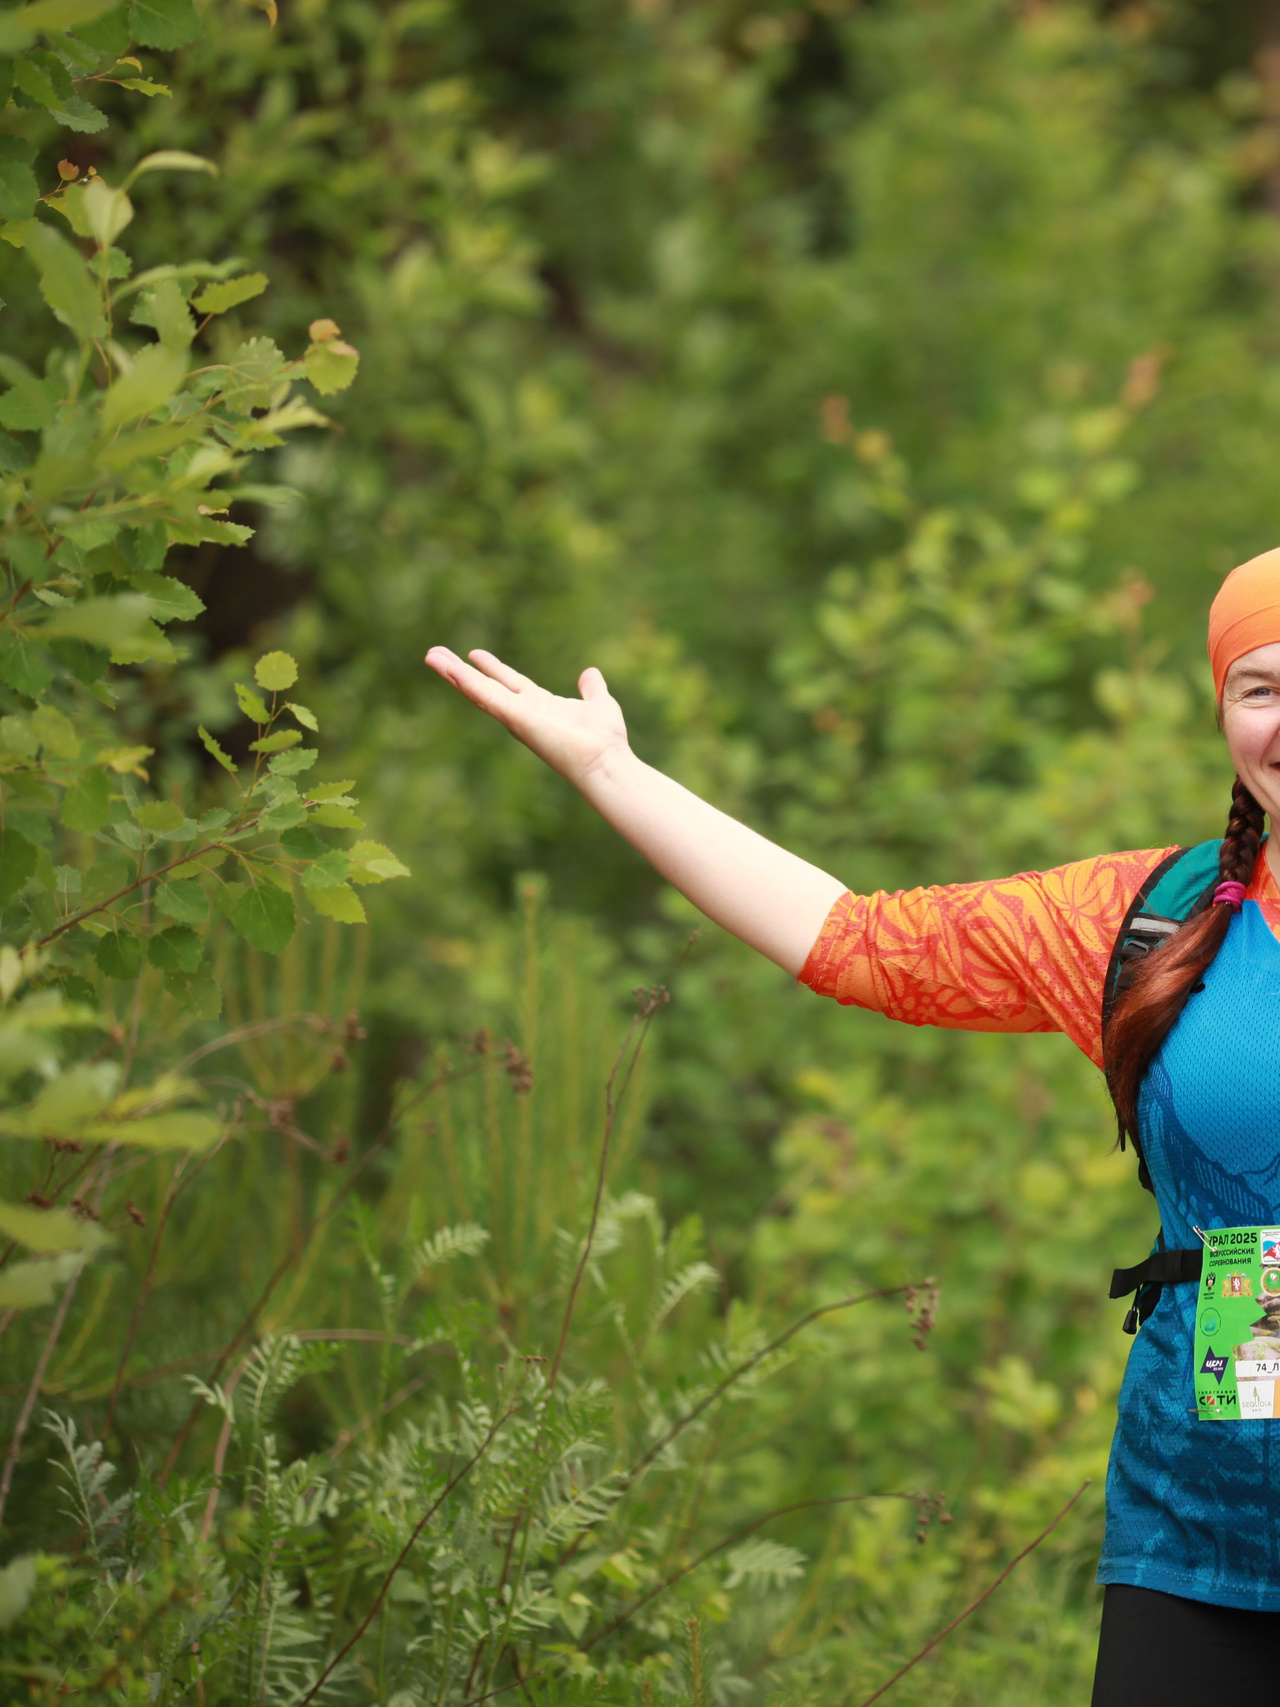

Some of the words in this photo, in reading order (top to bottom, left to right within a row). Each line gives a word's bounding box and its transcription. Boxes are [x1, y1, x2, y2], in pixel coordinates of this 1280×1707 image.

[1230, 1233, 1257, 1244] 2025
[1210, 1247, 1255, 1258] ВСЕРОССИЙСКИЕ
[1209, 1257, 1252, 1267] СОРЕВНОВАНИЯ
